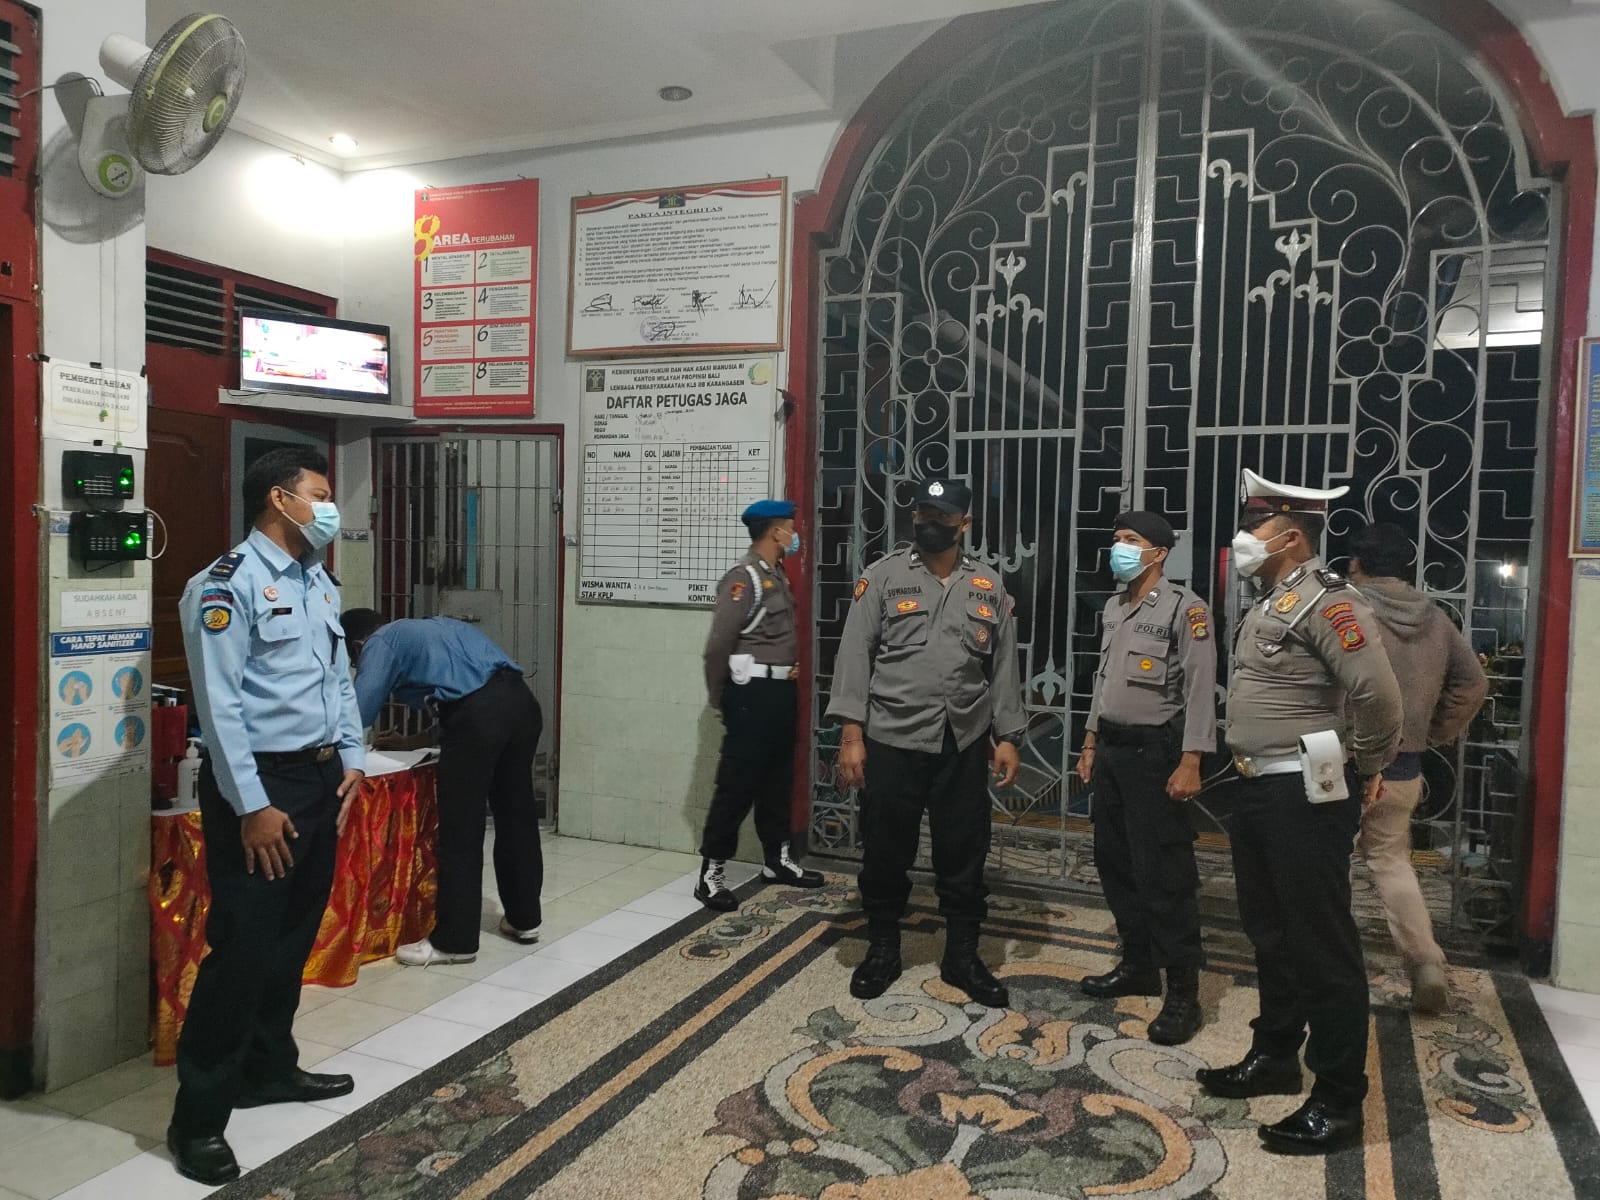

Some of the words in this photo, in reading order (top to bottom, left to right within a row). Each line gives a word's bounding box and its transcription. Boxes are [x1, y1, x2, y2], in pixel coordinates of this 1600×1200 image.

[628, 211, 660, 219] PAKTA
[663, 206, 722, 217] INTEGRITAS
[432, 233, 470, 246] AREA
[478, 252, 487, 270] 2
[423, 292, 433, 309] 3
[478, 288, 488, 304] 4
[423, 330, 433, 346] 5
[477, 325, 488, 342] 6
[423, 366, 433, 384] 7
[476, 362, 487, 379] 8
[59, 372, 131, 390] PEMBERITAHUAN
[607, 396, 653, 409] DAFTAR
[656, 393, 712, 408] PETUGAS
[715, 392, 747, 406] JAGA
[662, 450, 681, 458] JABATAN
[688, 584, 708, 592] PIKET
[73, 594, 115, 602] SUDAHKAH
[1136, 624, 1169, 638] POLRI
[60, 636, 83, 644] CARA
[97, 640, 135, 648] SANITIZER
